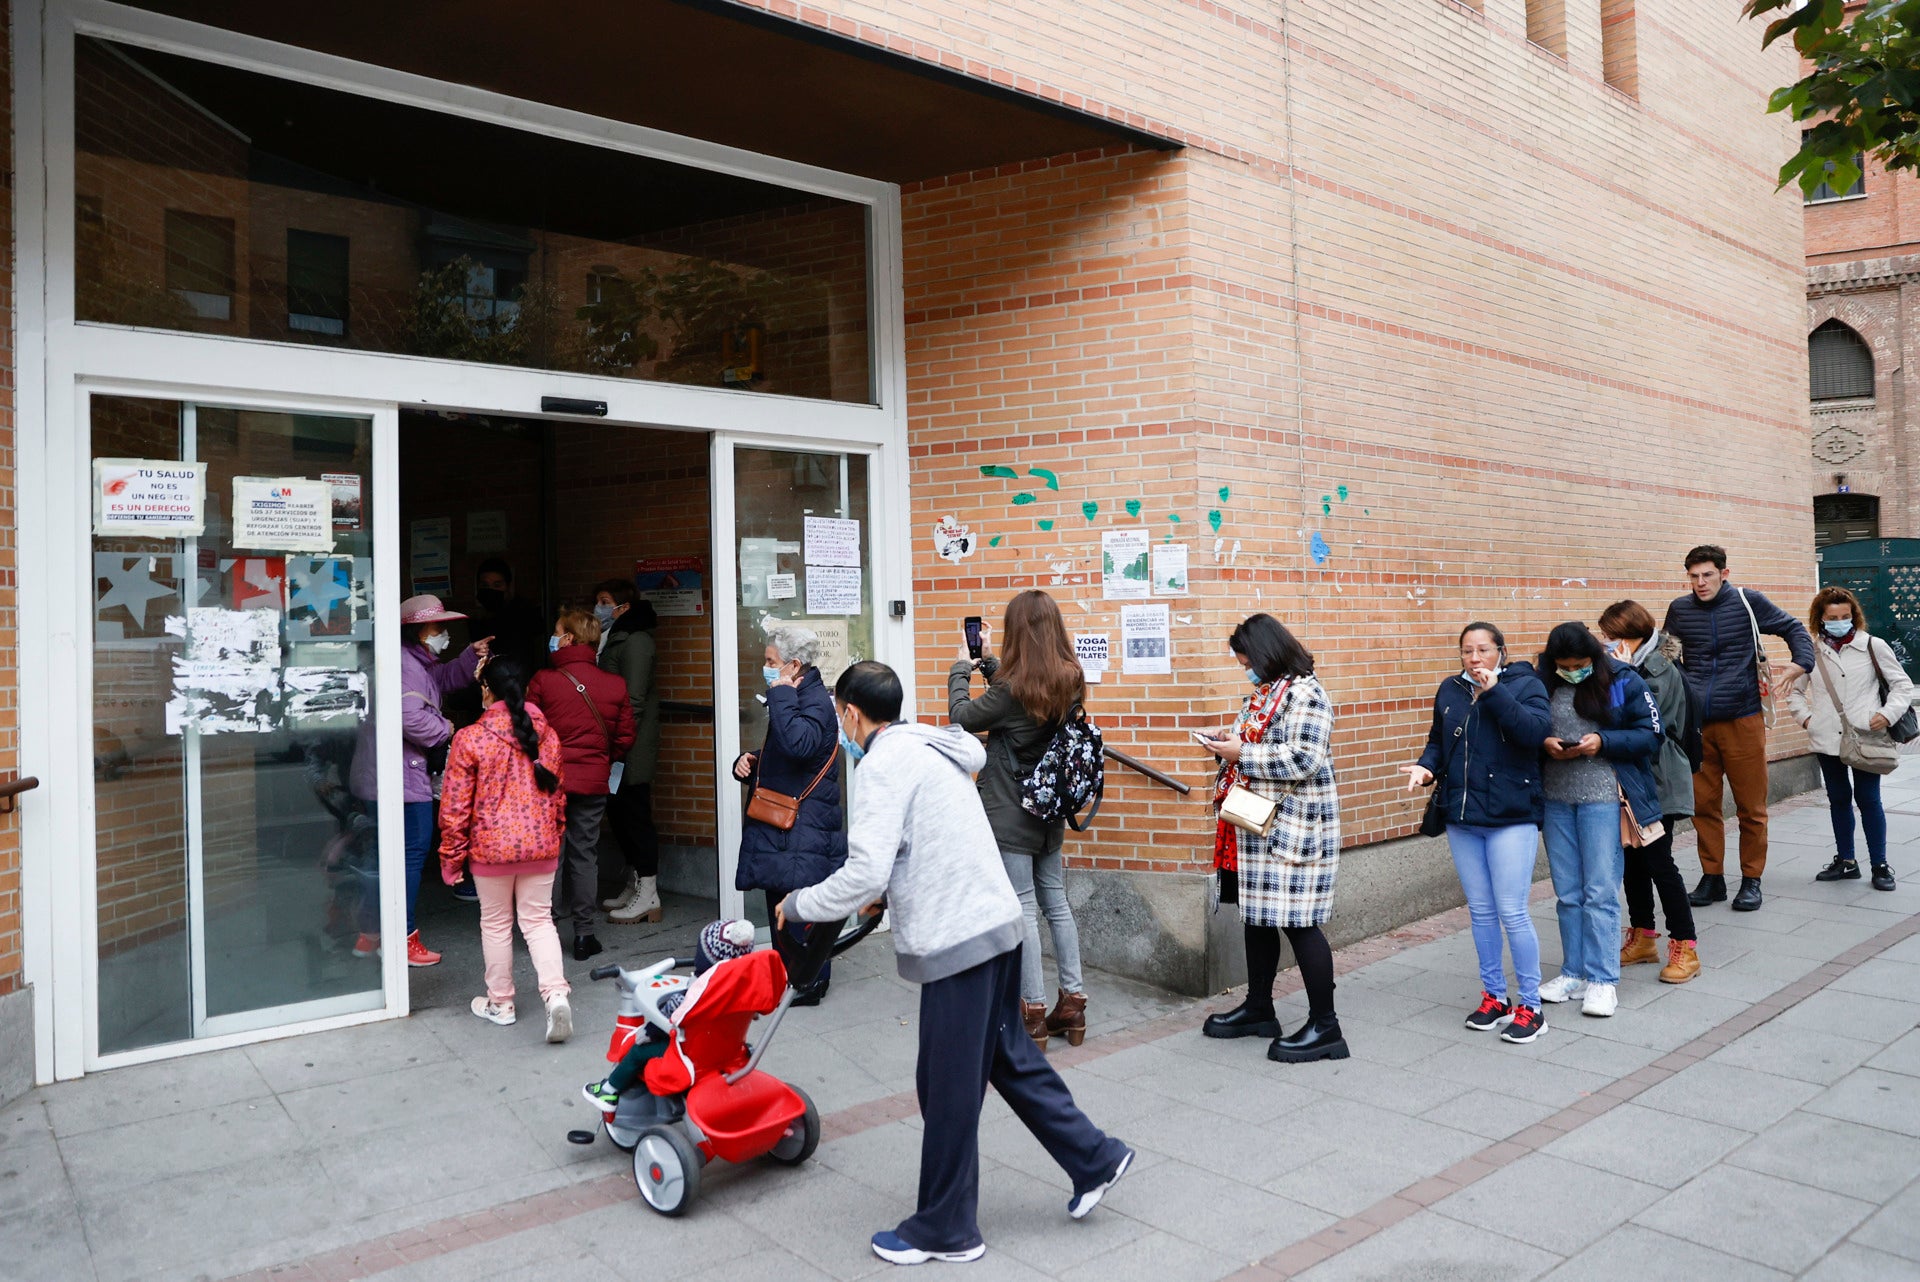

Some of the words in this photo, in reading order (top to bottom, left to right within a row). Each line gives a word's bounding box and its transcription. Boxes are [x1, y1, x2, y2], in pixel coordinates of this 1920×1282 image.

[138, 470, 153, 478] TU
[157, 470, 195, 479] SALUD
[282, 488, 292, 496] M
